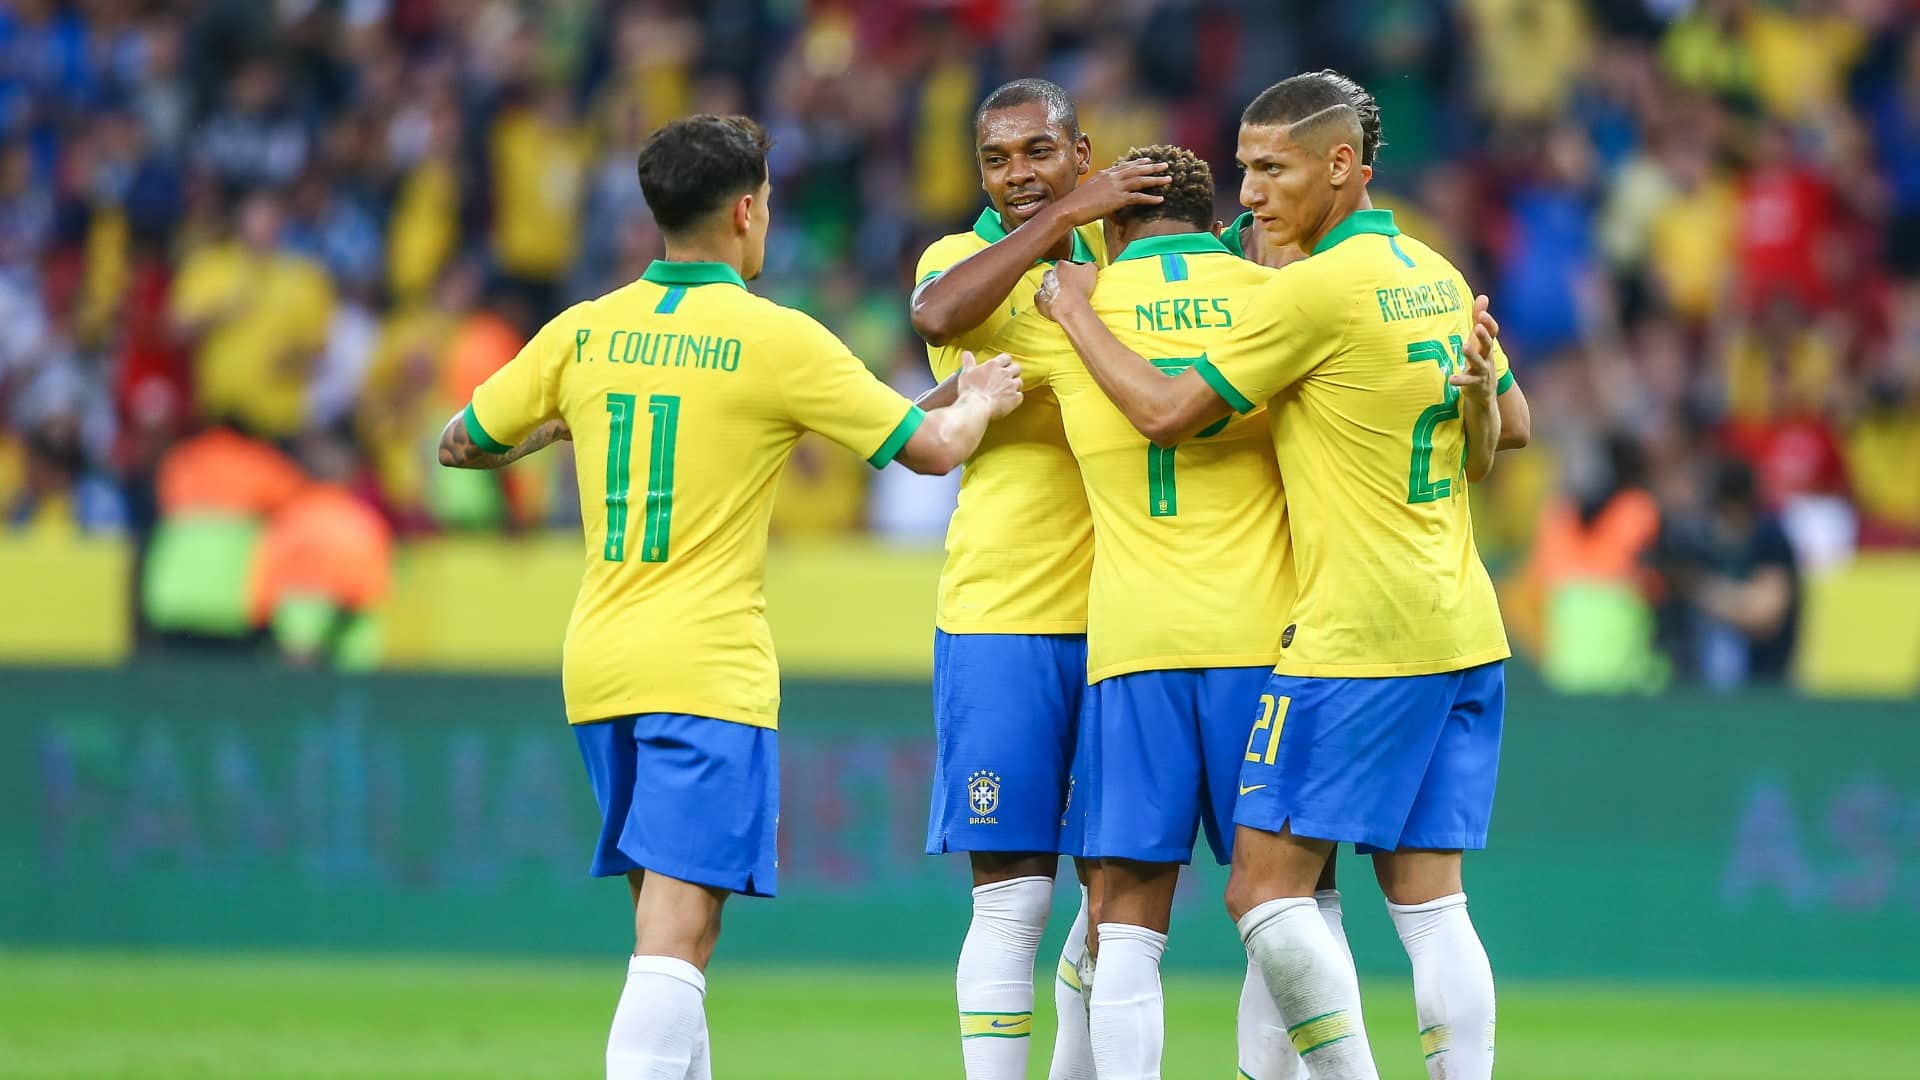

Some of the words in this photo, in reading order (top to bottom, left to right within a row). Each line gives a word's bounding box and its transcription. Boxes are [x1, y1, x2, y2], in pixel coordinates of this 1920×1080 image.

[1136, 298, 1232, 331] NERES
[576, 329, 593, 363] P.
[608, 330, 742, 372] COUTINHO
[606, 393, 681, 562] 11
[1245, 694, 1291, 766] 21
[969, 817, 998, 825] BRASIL
